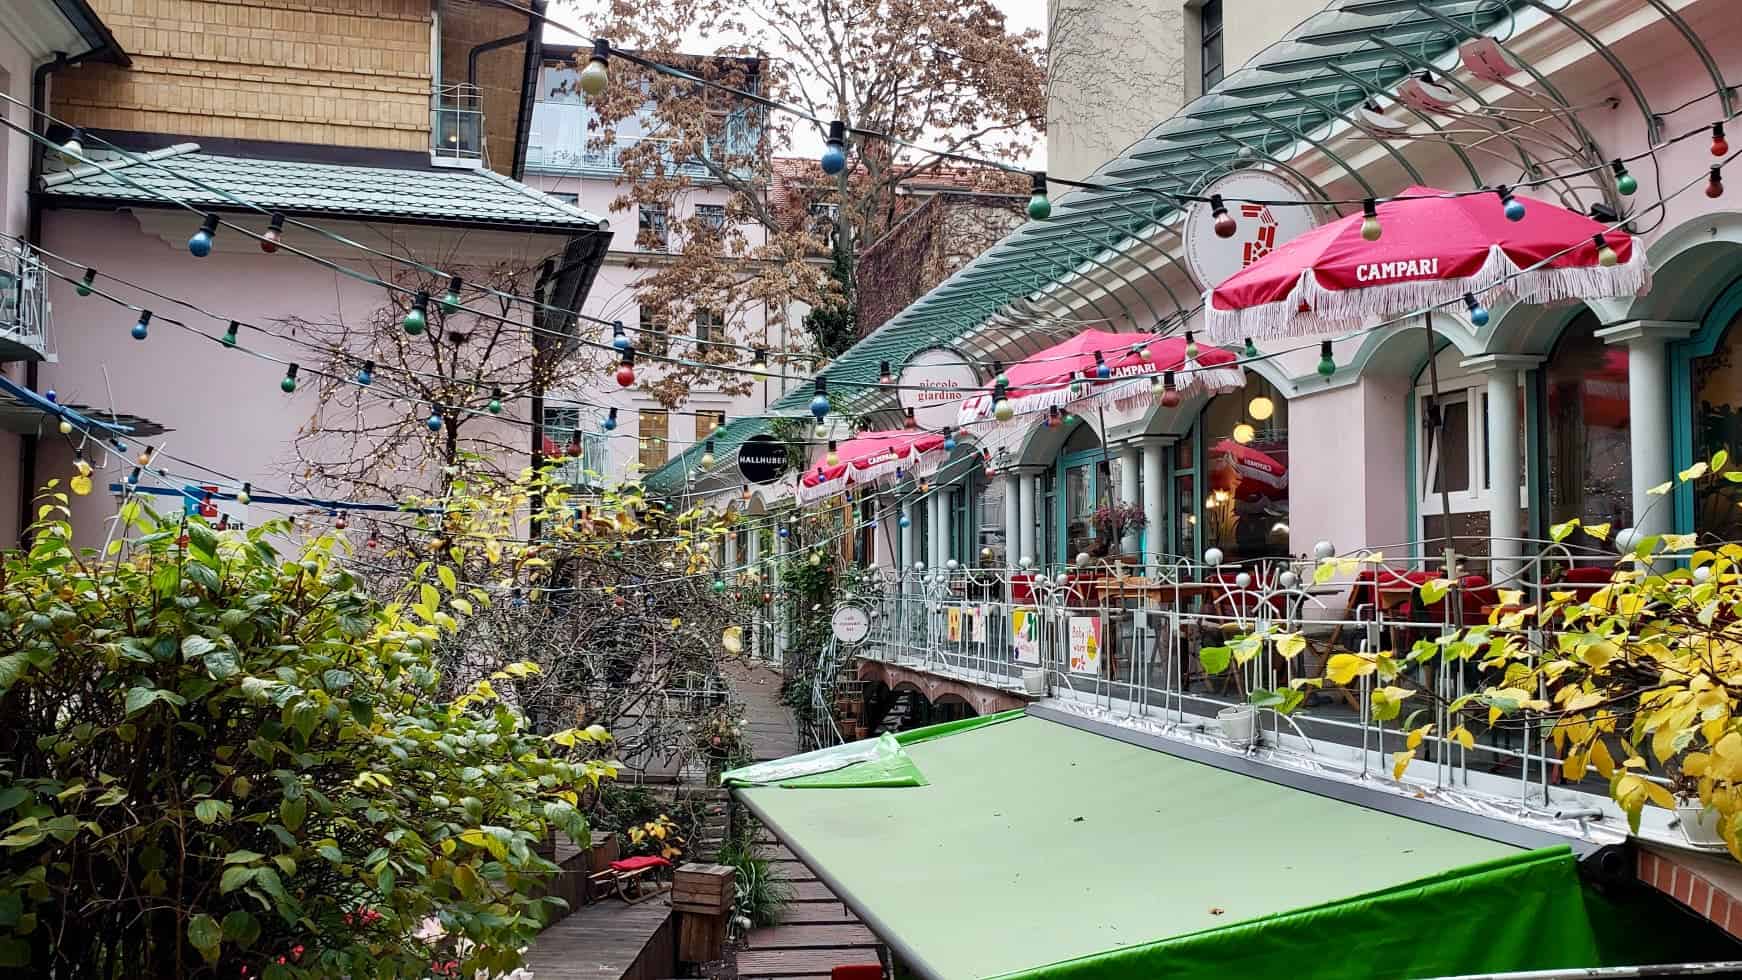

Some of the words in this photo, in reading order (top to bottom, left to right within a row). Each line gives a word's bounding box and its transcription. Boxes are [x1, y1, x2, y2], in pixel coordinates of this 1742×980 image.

[1357, 258, 1438, 281] CAMPARI
[1109, 363, 1156, 377] CAMPARI
[920, 379, 958, 391] piccolo
[918, 390, 962, 401] giardino
[867, 451, 896, 465] CAMPA
